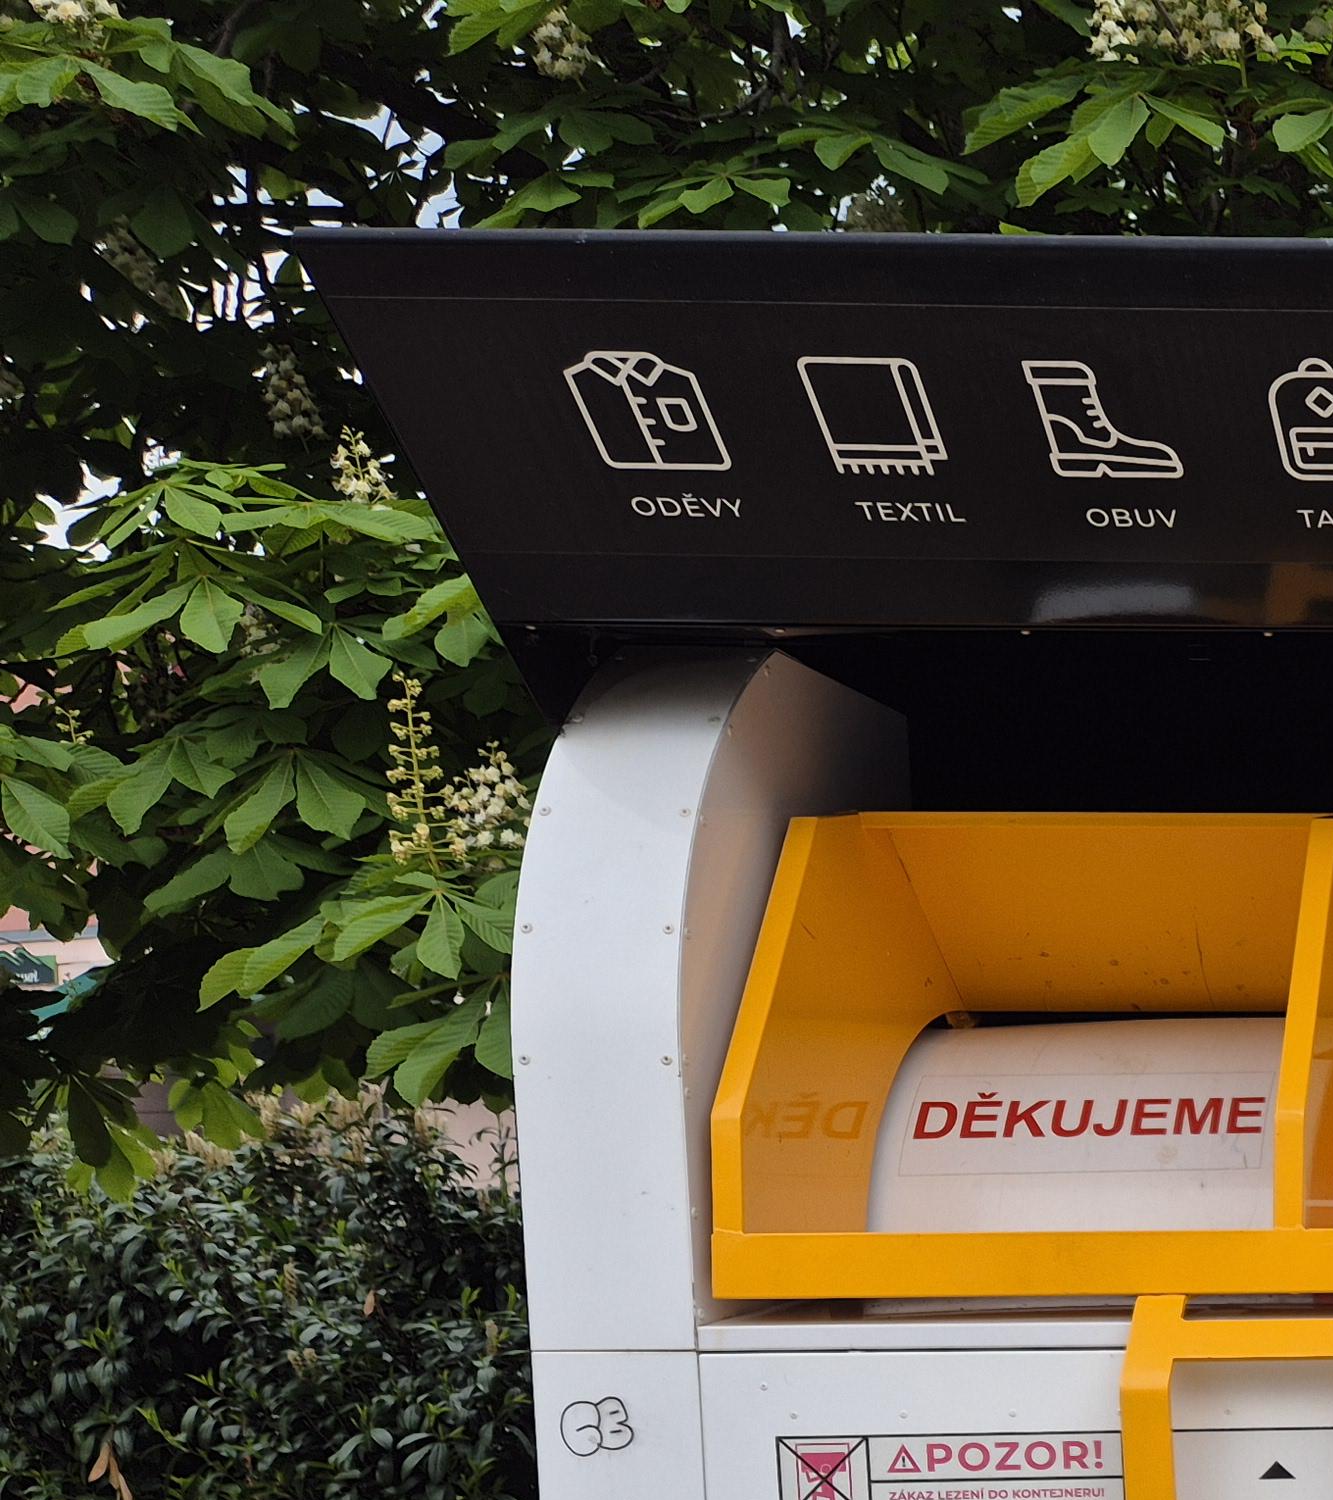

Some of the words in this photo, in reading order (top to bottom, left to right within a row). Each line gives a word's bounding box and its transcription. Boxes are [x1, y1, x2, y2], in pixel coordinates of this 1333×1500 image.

[630, 492, 741, 518] ODĚVY
[854, 501, 966, 523] TEXTIL
[1086, 507, 1177, 529] OBUV
[911, 1091, 1266, 1141] DĚKUJEME
[925, 1439, 1104, 1473] POZOR!
[937, 1488, 984, 1500] LEZENÍ
[987, 1490, 1009, 1500] DO
[1012, 1487, 1105, 1499] KONTEJNERU!
